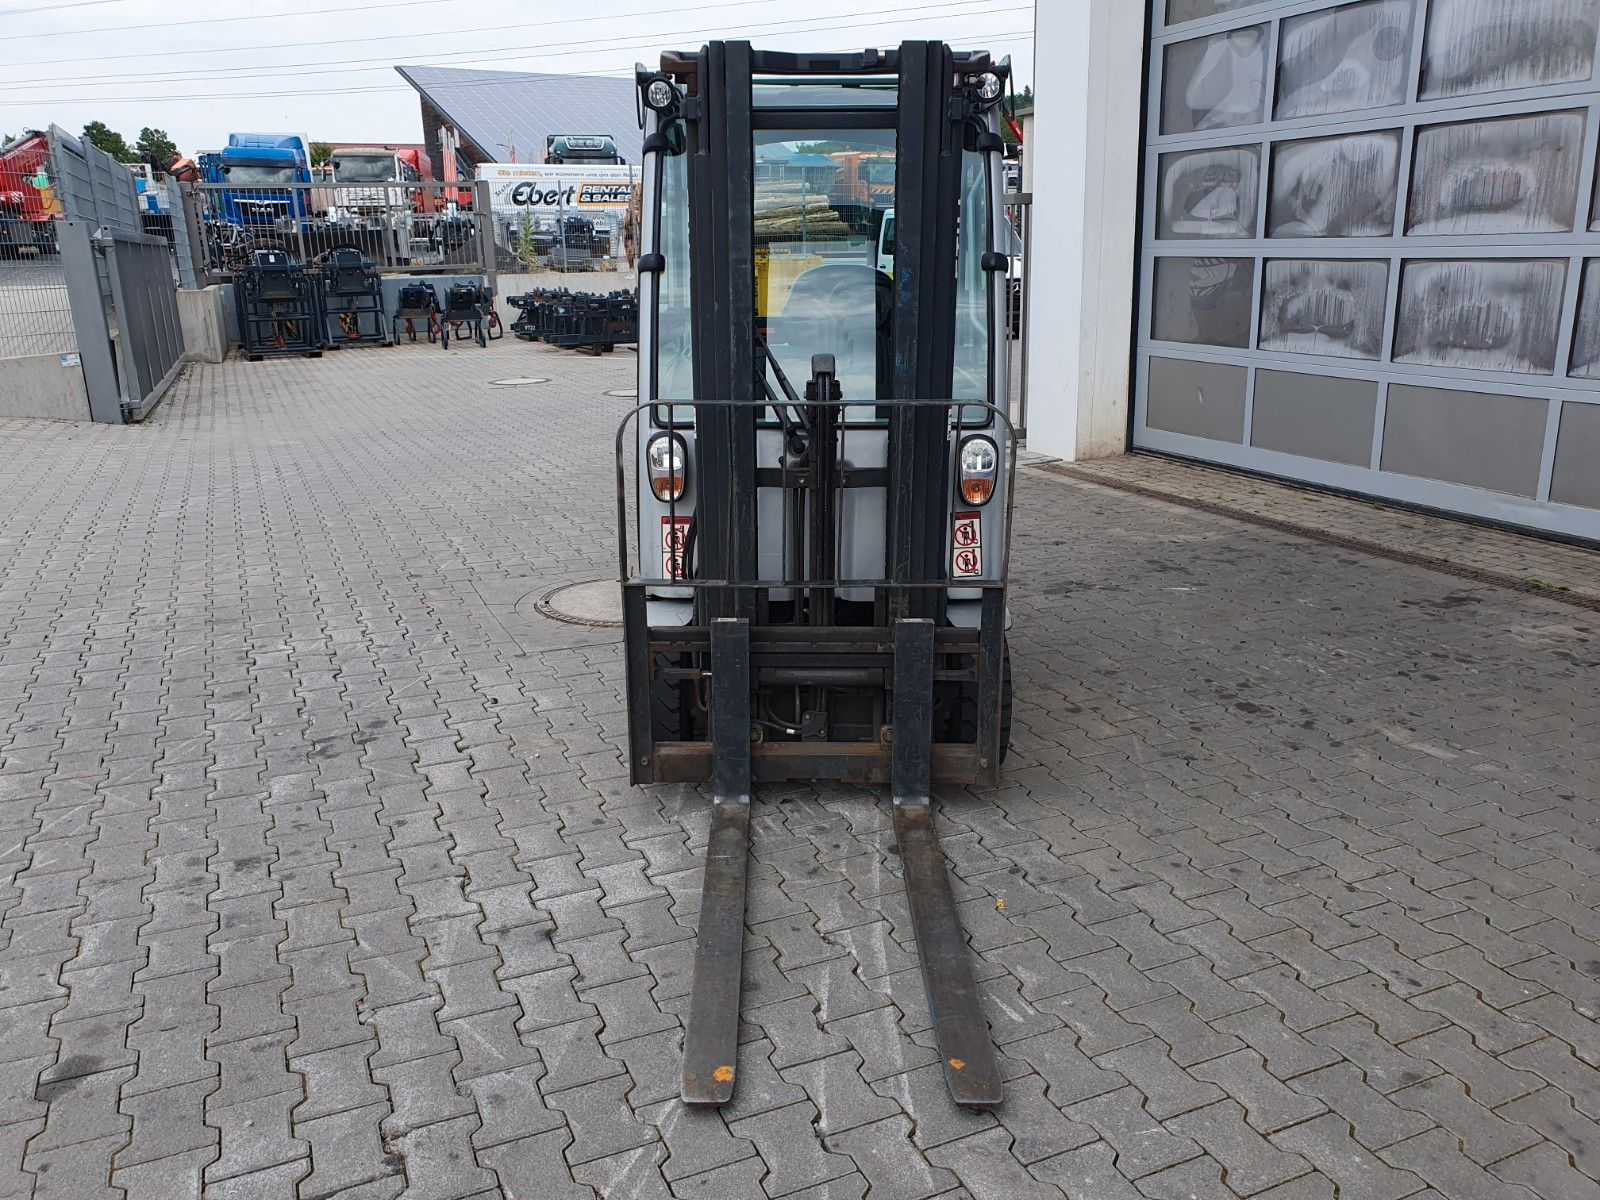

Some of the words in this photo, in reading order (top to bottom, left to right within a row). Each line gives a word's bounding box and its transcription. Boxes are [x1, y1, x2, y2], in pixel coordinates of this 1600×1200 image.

[512, 181, 576, 206] Ebert
[580, 194, 591, 202] &
[592, 194, 633, 202] SALES
